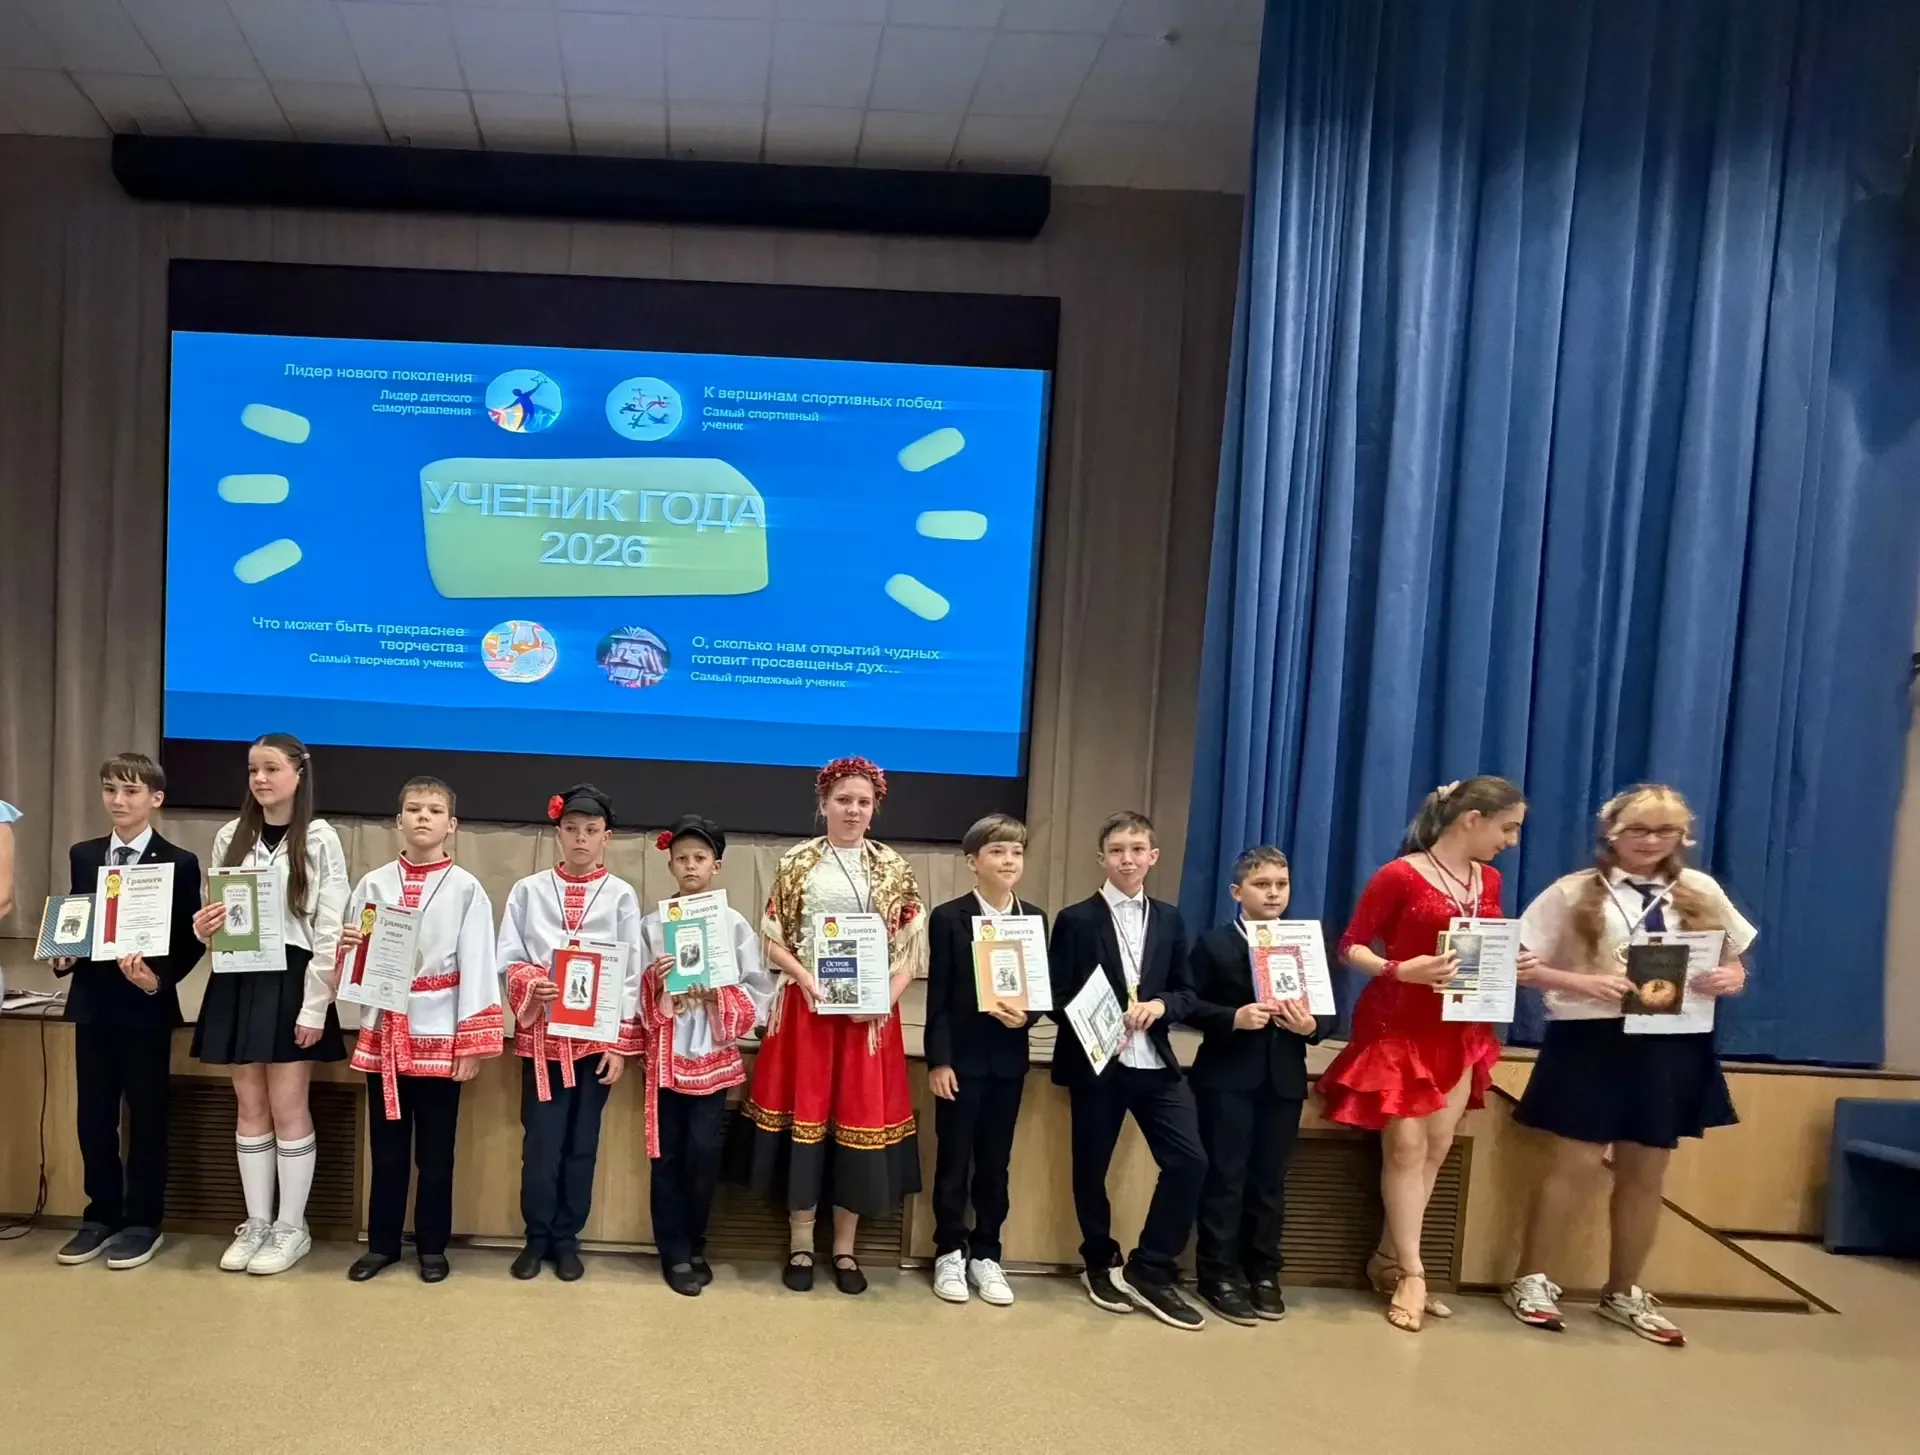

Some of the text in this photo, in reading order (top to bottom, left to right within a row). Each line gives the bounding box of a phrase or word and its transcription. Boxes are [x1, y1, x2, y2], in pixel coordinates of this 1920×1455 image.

[284, 364, 472, 383] Лидер нового поколения
[380, 390, 472, 403] Лидер детского
[704, 387, 942, 410] К вершинам спортивных побед
[372, 403, 471, 416] самоуправления
[703, 407, 819, 422] Самый спортивный
[702, 421, 744, 431] ученик
[425, 480, 766, 533] УЧЕНИК ГОДА
[539, 531, 649, 567] 2026
[252, 617, 465, 637] Что может быть прекраснее
[380, 640, 464, 653] творчества
[692, 636, 940, 660] О, сколько нам открытий чудных
[309, 653, 464, 669] Самый творческий ученик
[691, 655, 748, 666] готовит
[752, 657, 853, 672] просвещенья
[691, 672, 847, 689] Самый прилежный ученик
